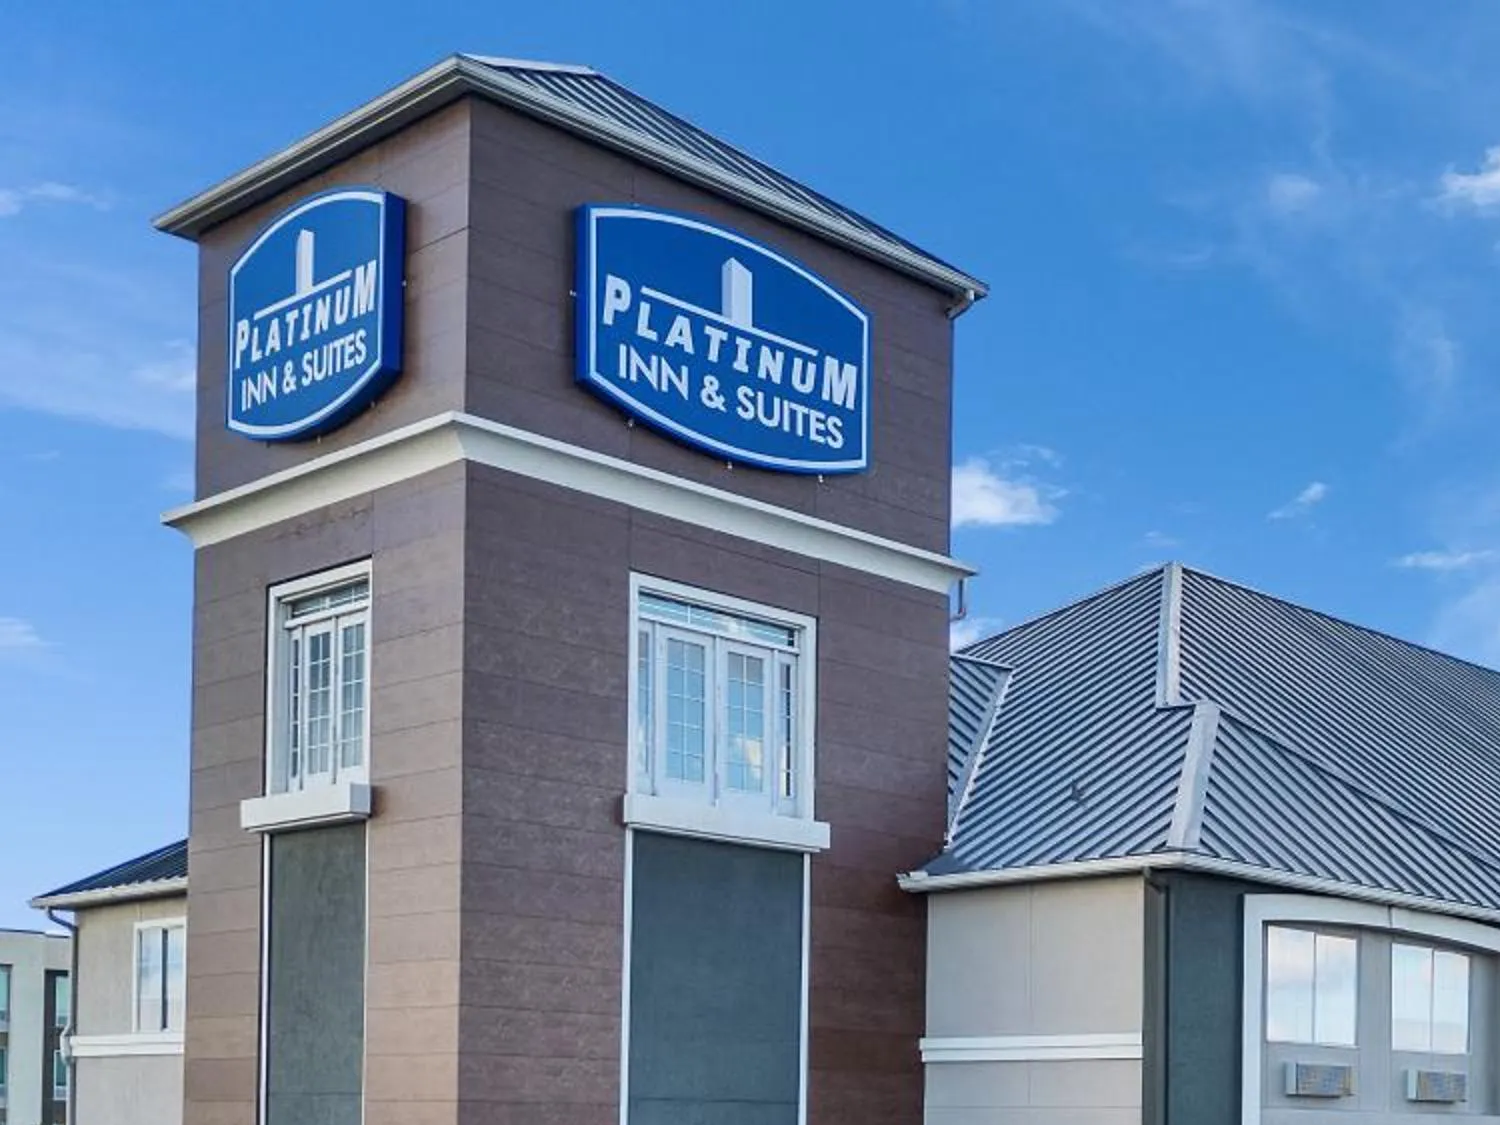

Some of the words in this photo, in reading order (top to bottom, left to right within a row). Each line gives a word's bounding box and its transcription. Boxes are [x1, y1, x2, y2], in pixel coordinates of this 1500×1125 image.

[235, 259, 377, 369] PLATINUM
[602, 273, 858, 411] PLATINUM
[241, 365, 278, 413] INN
[281, 359, 297, 395] &
[301, 328, 368, 387] SUITES
[618, 343, 690, 401] INN
[699, 374, 728, 413] &
[736, 384, 845, 450] SUITES
